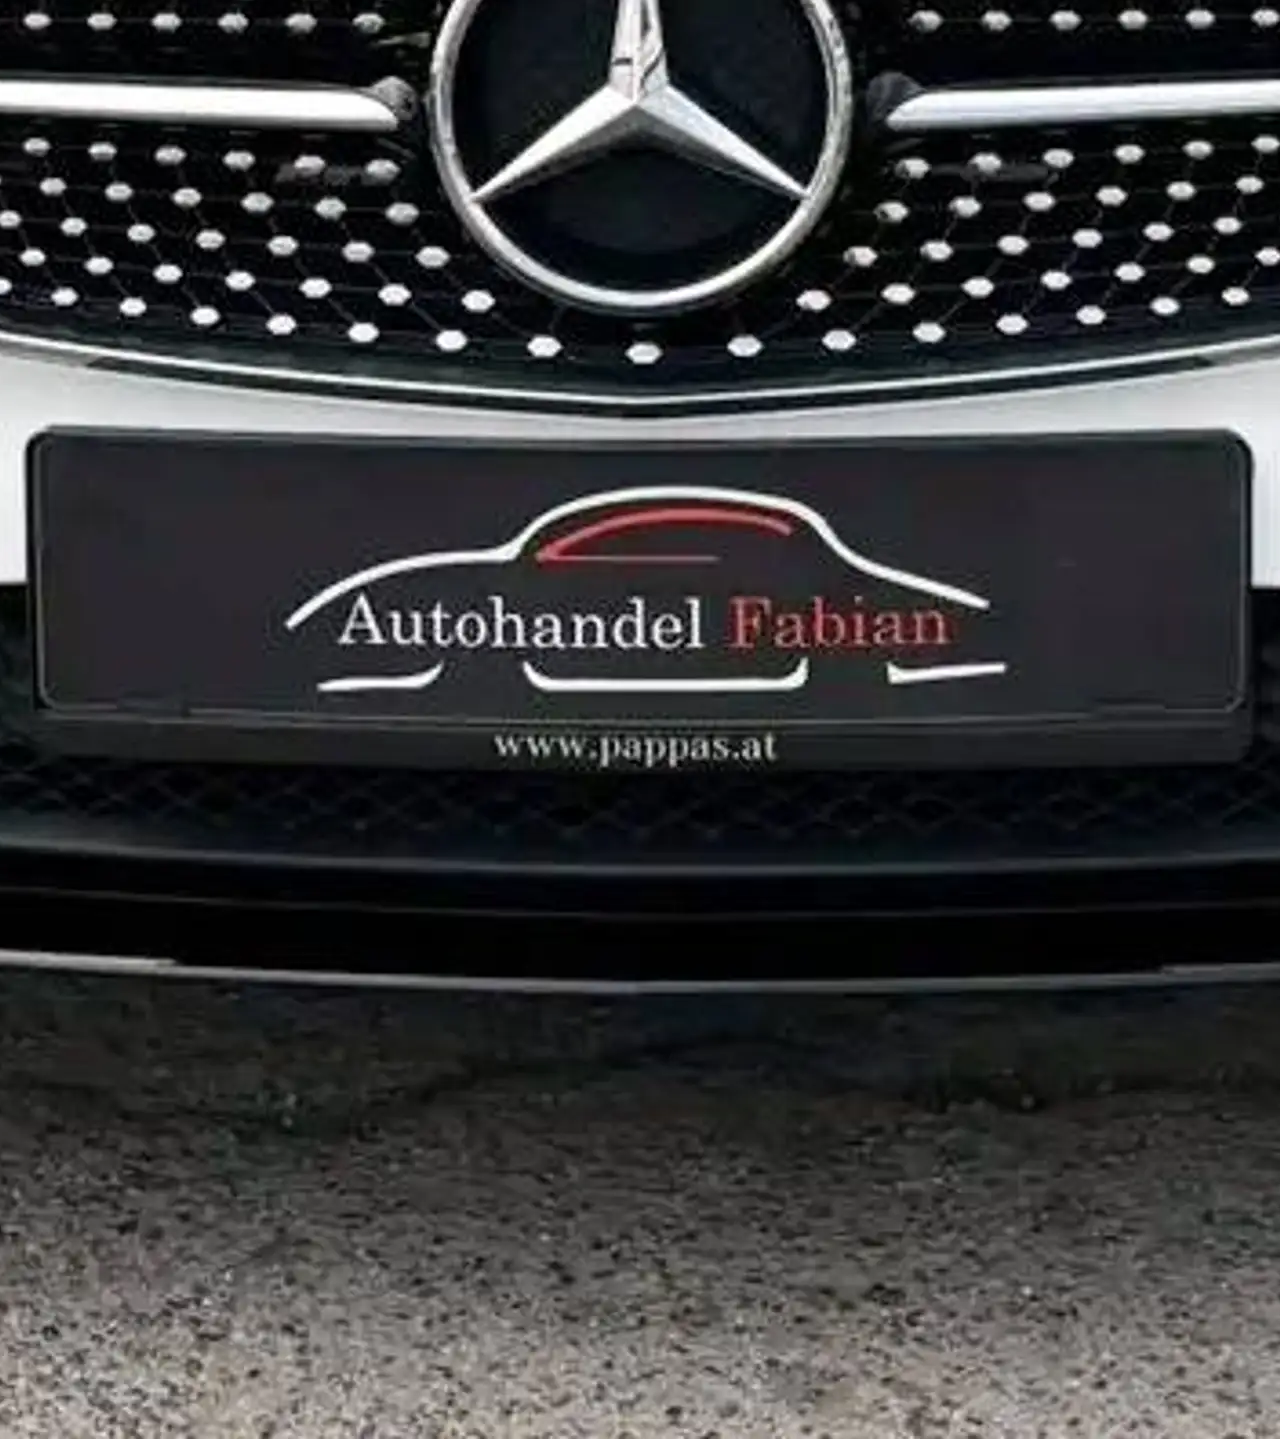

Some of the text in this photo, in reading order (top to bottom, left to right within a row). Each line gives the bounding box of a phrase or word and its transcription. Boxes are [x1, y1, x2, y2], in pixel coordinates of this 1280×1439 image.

[337, 593, 954, 649] Autohandel Fabian
[493, 729, 779, 768] www.pappas.at
